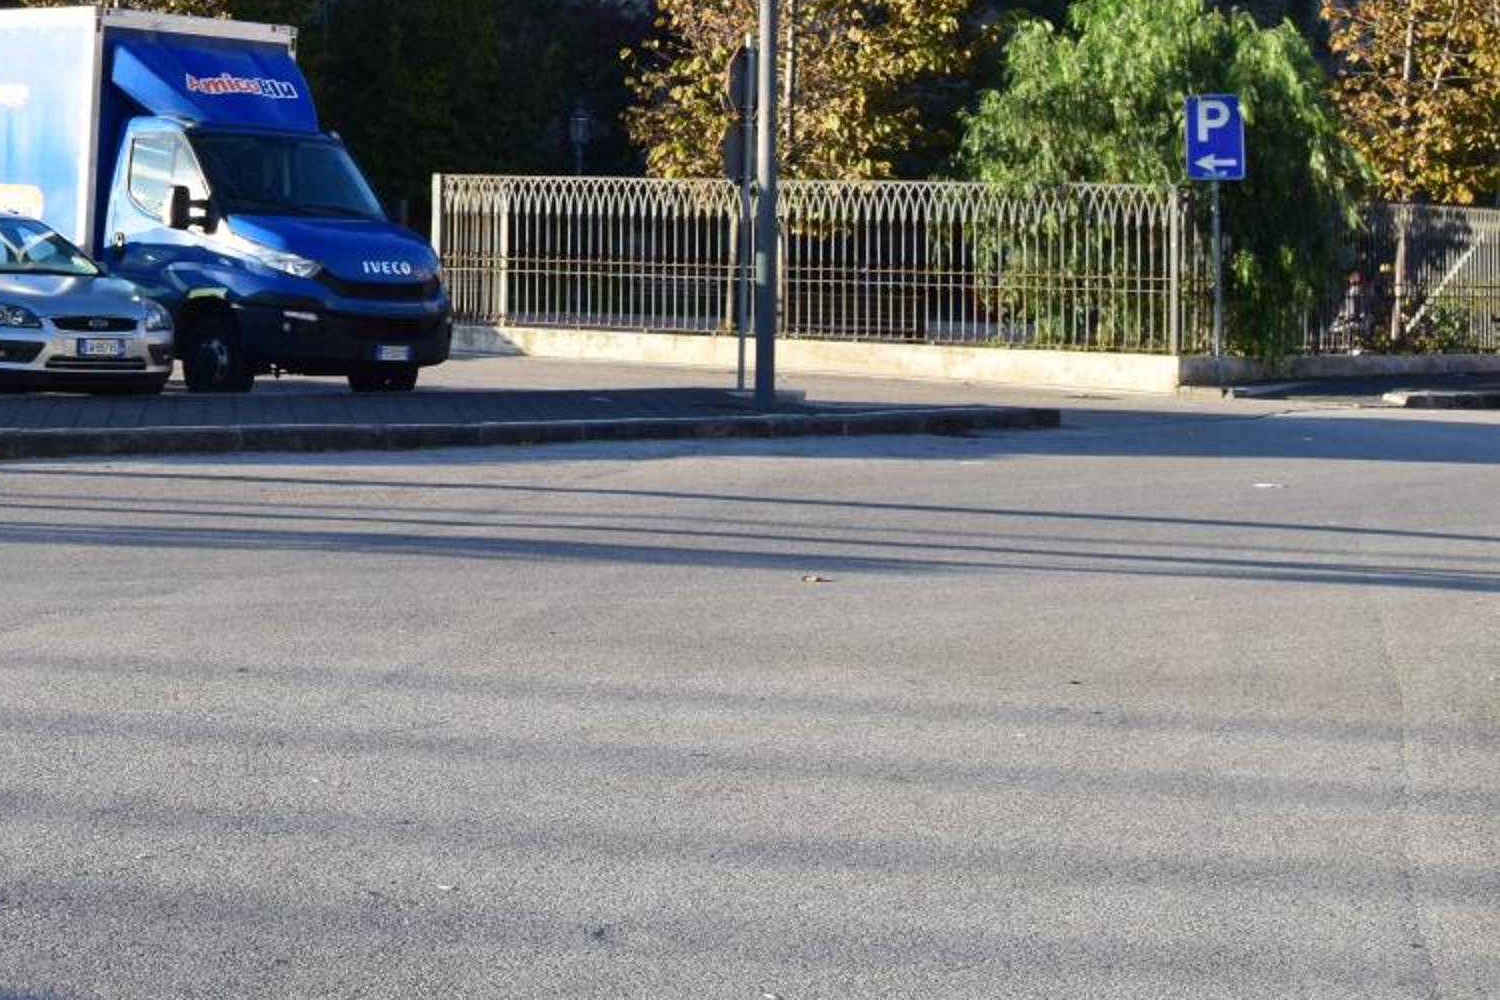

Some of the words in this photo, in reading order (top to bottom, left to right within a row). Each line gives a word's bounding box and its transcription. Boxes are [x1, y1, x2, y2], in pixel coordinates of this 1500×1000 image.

[185, 72, 299, 99] AmicoBlu
[1198, 100, 1230, 142] P
[362, 260, 411, 275] IVECO
